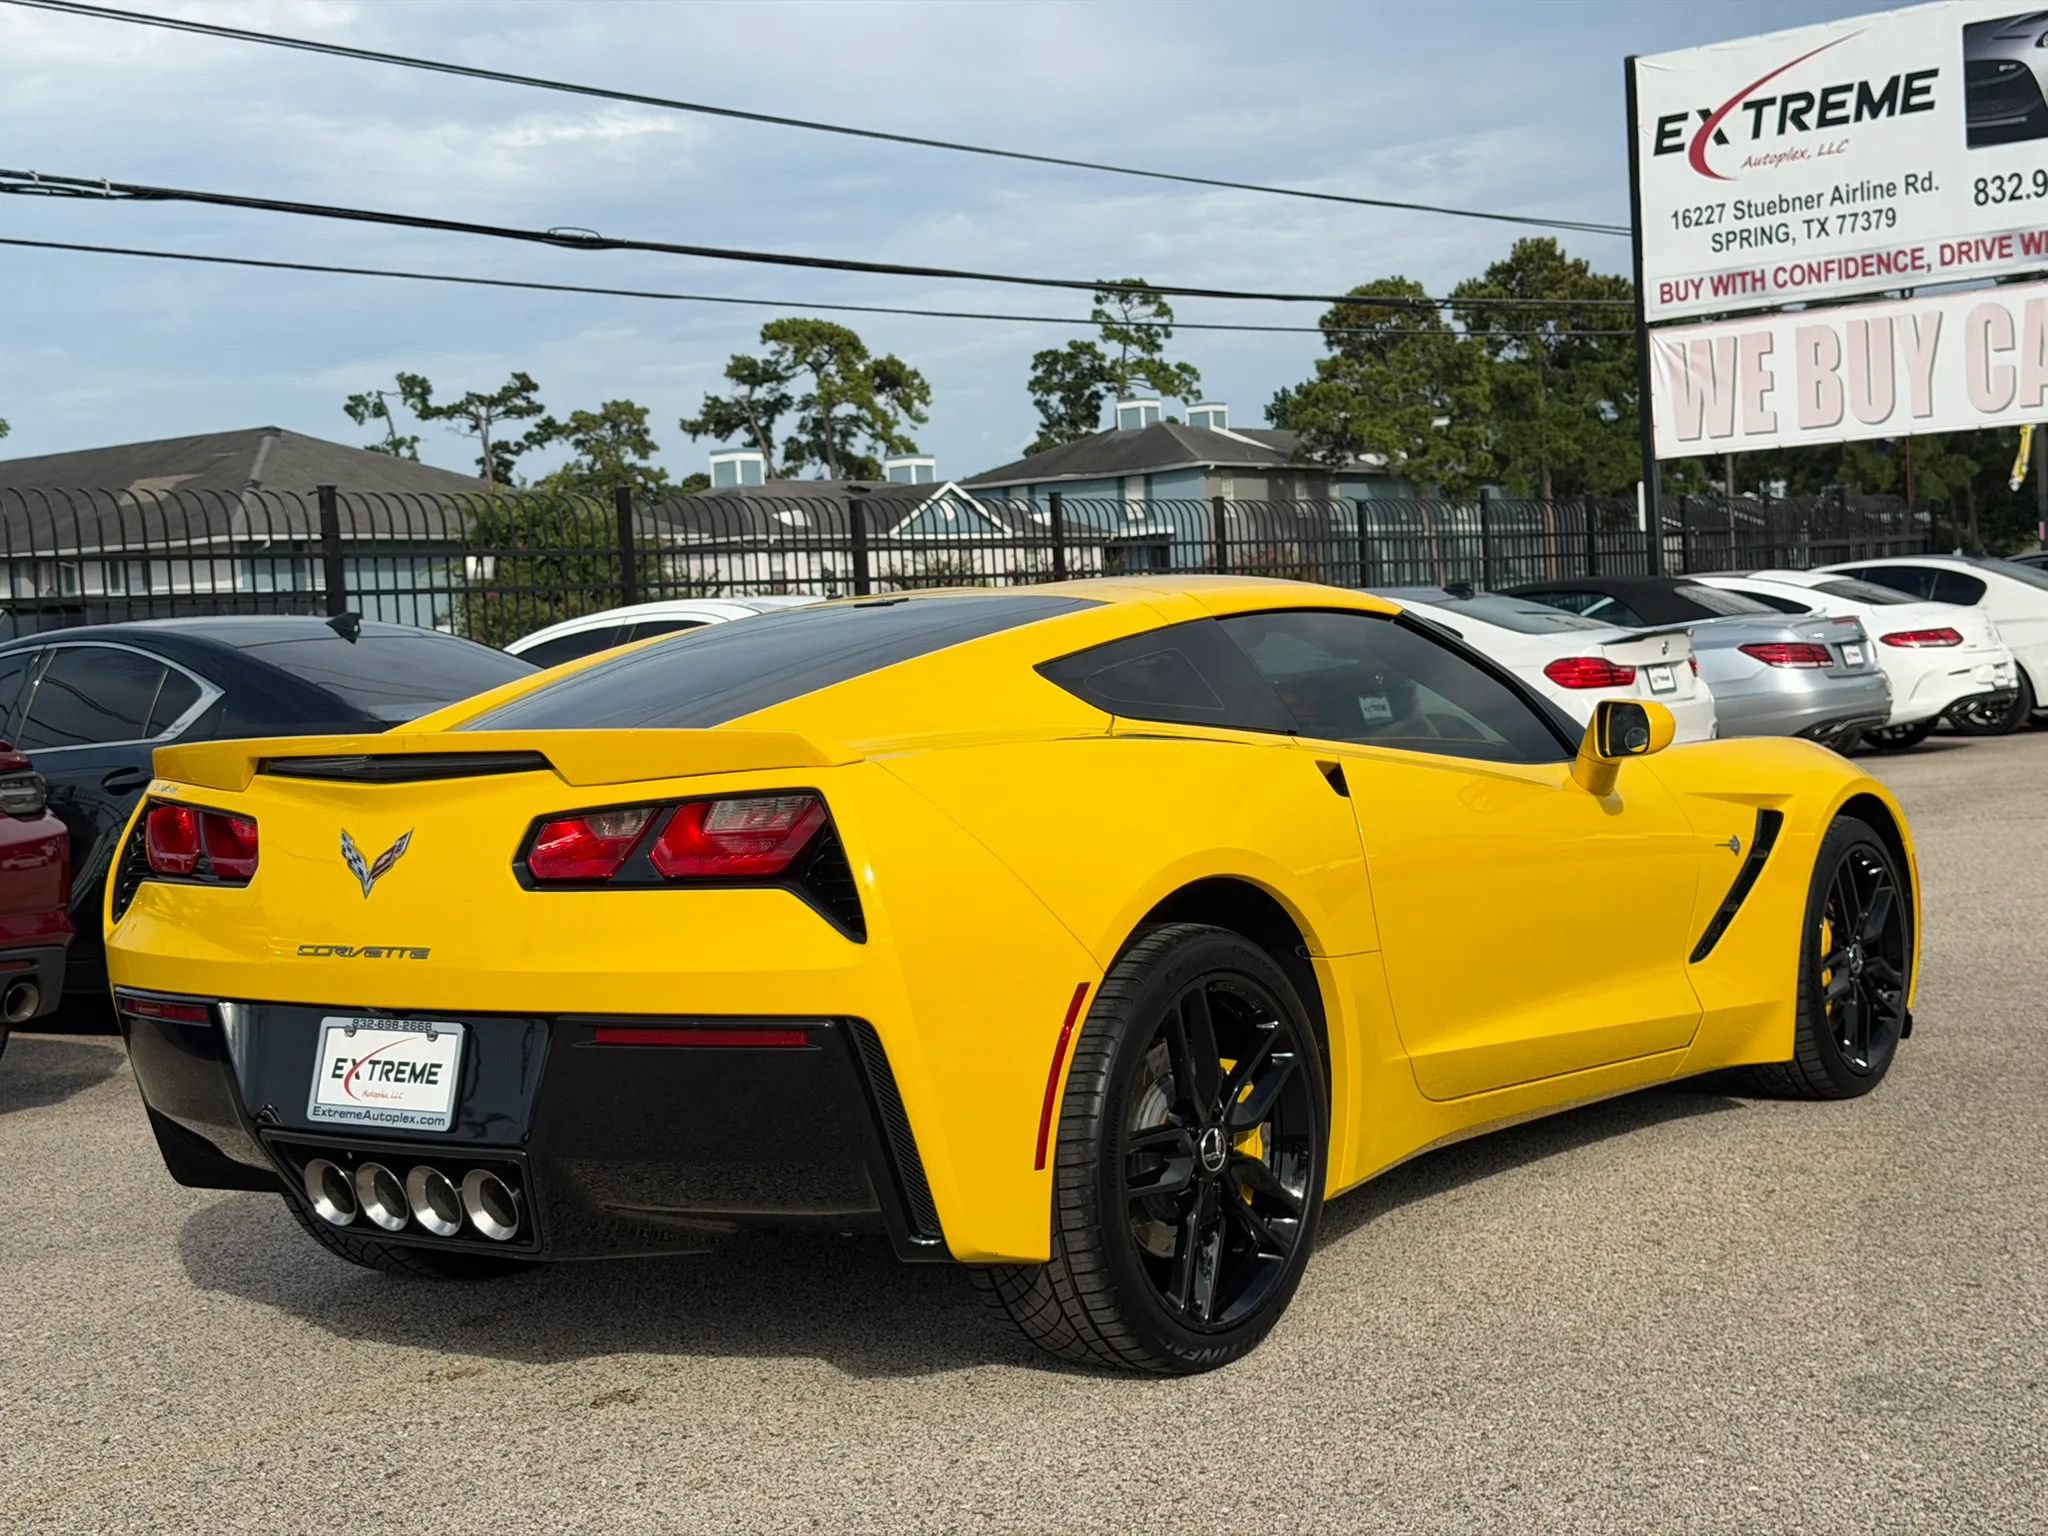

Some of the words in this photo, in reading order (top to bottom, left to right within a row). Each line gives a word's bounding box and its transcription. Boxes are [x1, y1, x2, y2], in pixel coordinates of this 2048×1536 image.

[1653, 68, 1940, 157] EXTREME
[1817, 139, 1850, 157] LLC
[1671, 204, 1726, 230] 16227
[1733, 193, 1824, 222] Stuebner
[1830, 181, 1897, 206] Airline
[1905, 171, 1940, 196] Rd.
[1711, 223, 1797, 253] SPRING,
[1803, 217, 1830, 240] TX
[1836, 207, 1897, 236] 77379
[1659, 278, 1704, 304] BUY
[1710, 270, 1766, 297] WITH
[1773, 247, 1932, 289] CONFIDENCE,
[1939, 235, 2014, 266] DRIVE
[1669, 331, 1778, 441] WE
[1795, 311, 1944, 430] BUY
[297, 945, 431, 960] CORVETTE
[331, 1057, 443, 1085] EXTREME
[312, 1106, 446, 1127] ExtremeAutoplex.com
